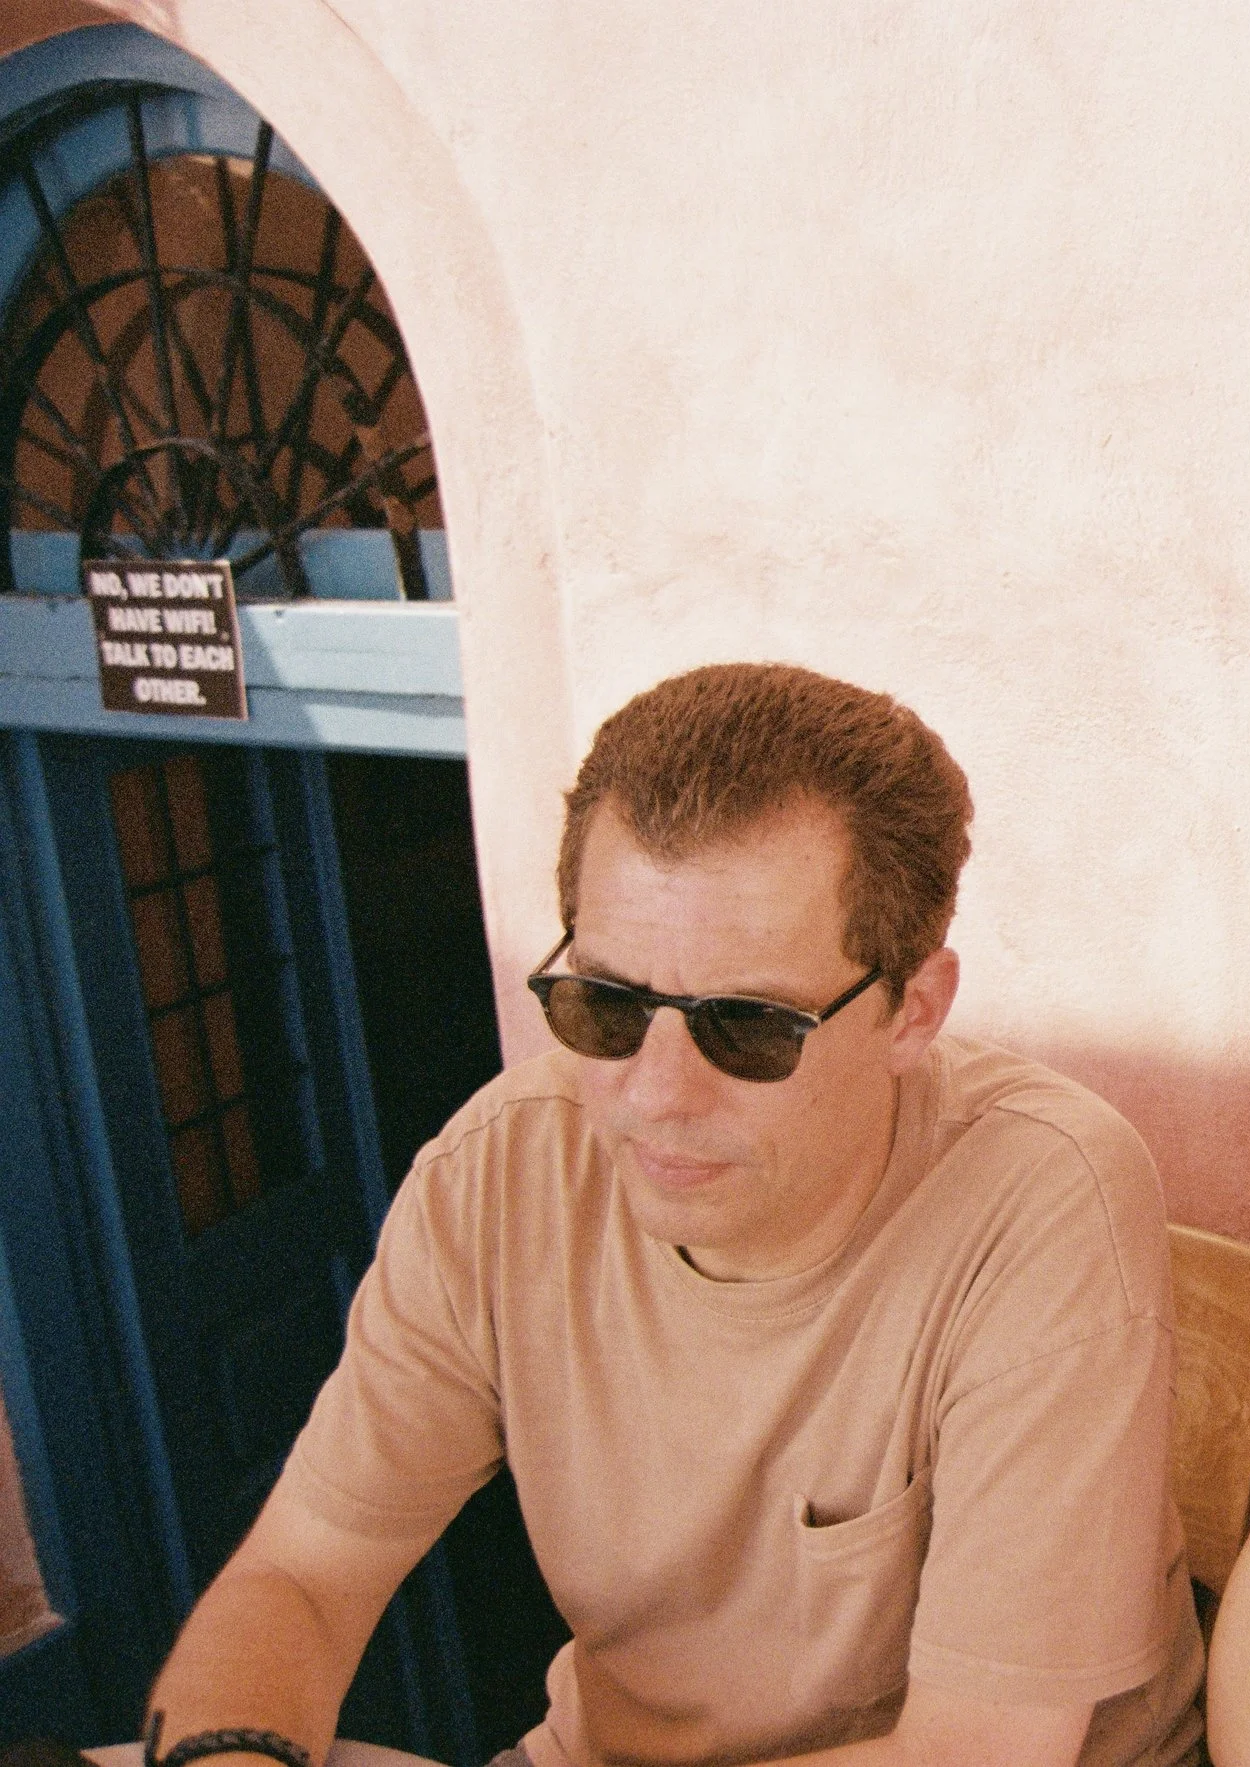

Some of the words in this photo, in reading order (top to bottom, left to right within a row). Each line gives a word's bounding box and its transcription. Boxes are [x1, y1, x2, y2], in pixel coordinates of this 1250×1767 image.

[90, 571, 128, 600] NO,
[126, 571, 163, 599] WE
[162, 572, 224, 599] DON'T
[108, 607, 163, 633] HAVE
[101, 641, 150, 667] TALK
[150, 643, 178, 669] TO
[178, 644, 235, 671] EACH
[133, 677, 207, 705] OTHER.
